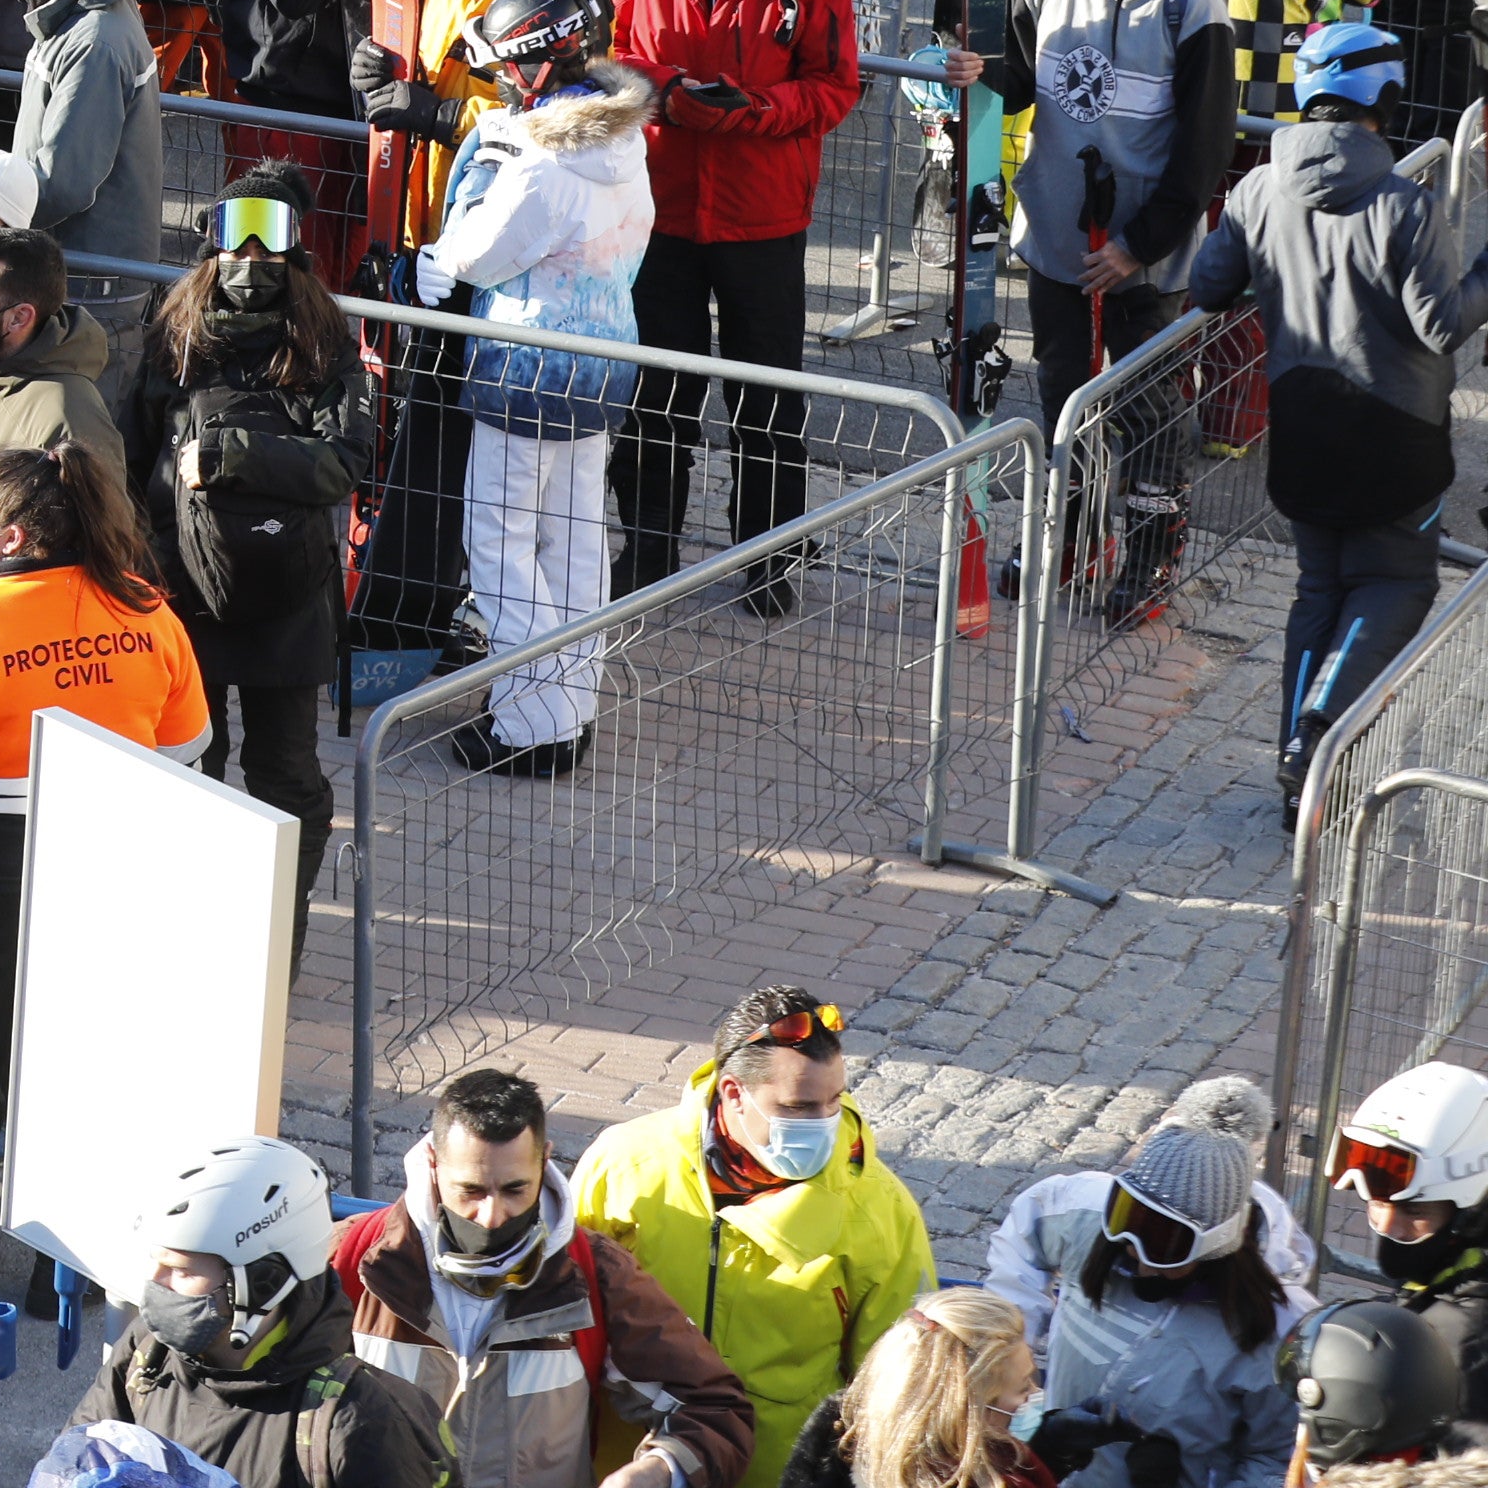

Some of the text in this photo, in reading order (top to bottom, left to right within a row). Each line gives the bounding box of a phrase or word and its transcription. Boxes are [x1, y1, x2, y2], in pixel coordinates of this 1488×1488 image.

[1057, 54, 1079, 79] FREE
[1055, 82, 1077, 117] XCESS
[1, 625, 154, 676] PROTECCIÓN
[53, 663, 114, 690] CIVIL
[235, 1200, 289, 1248] prosurf
